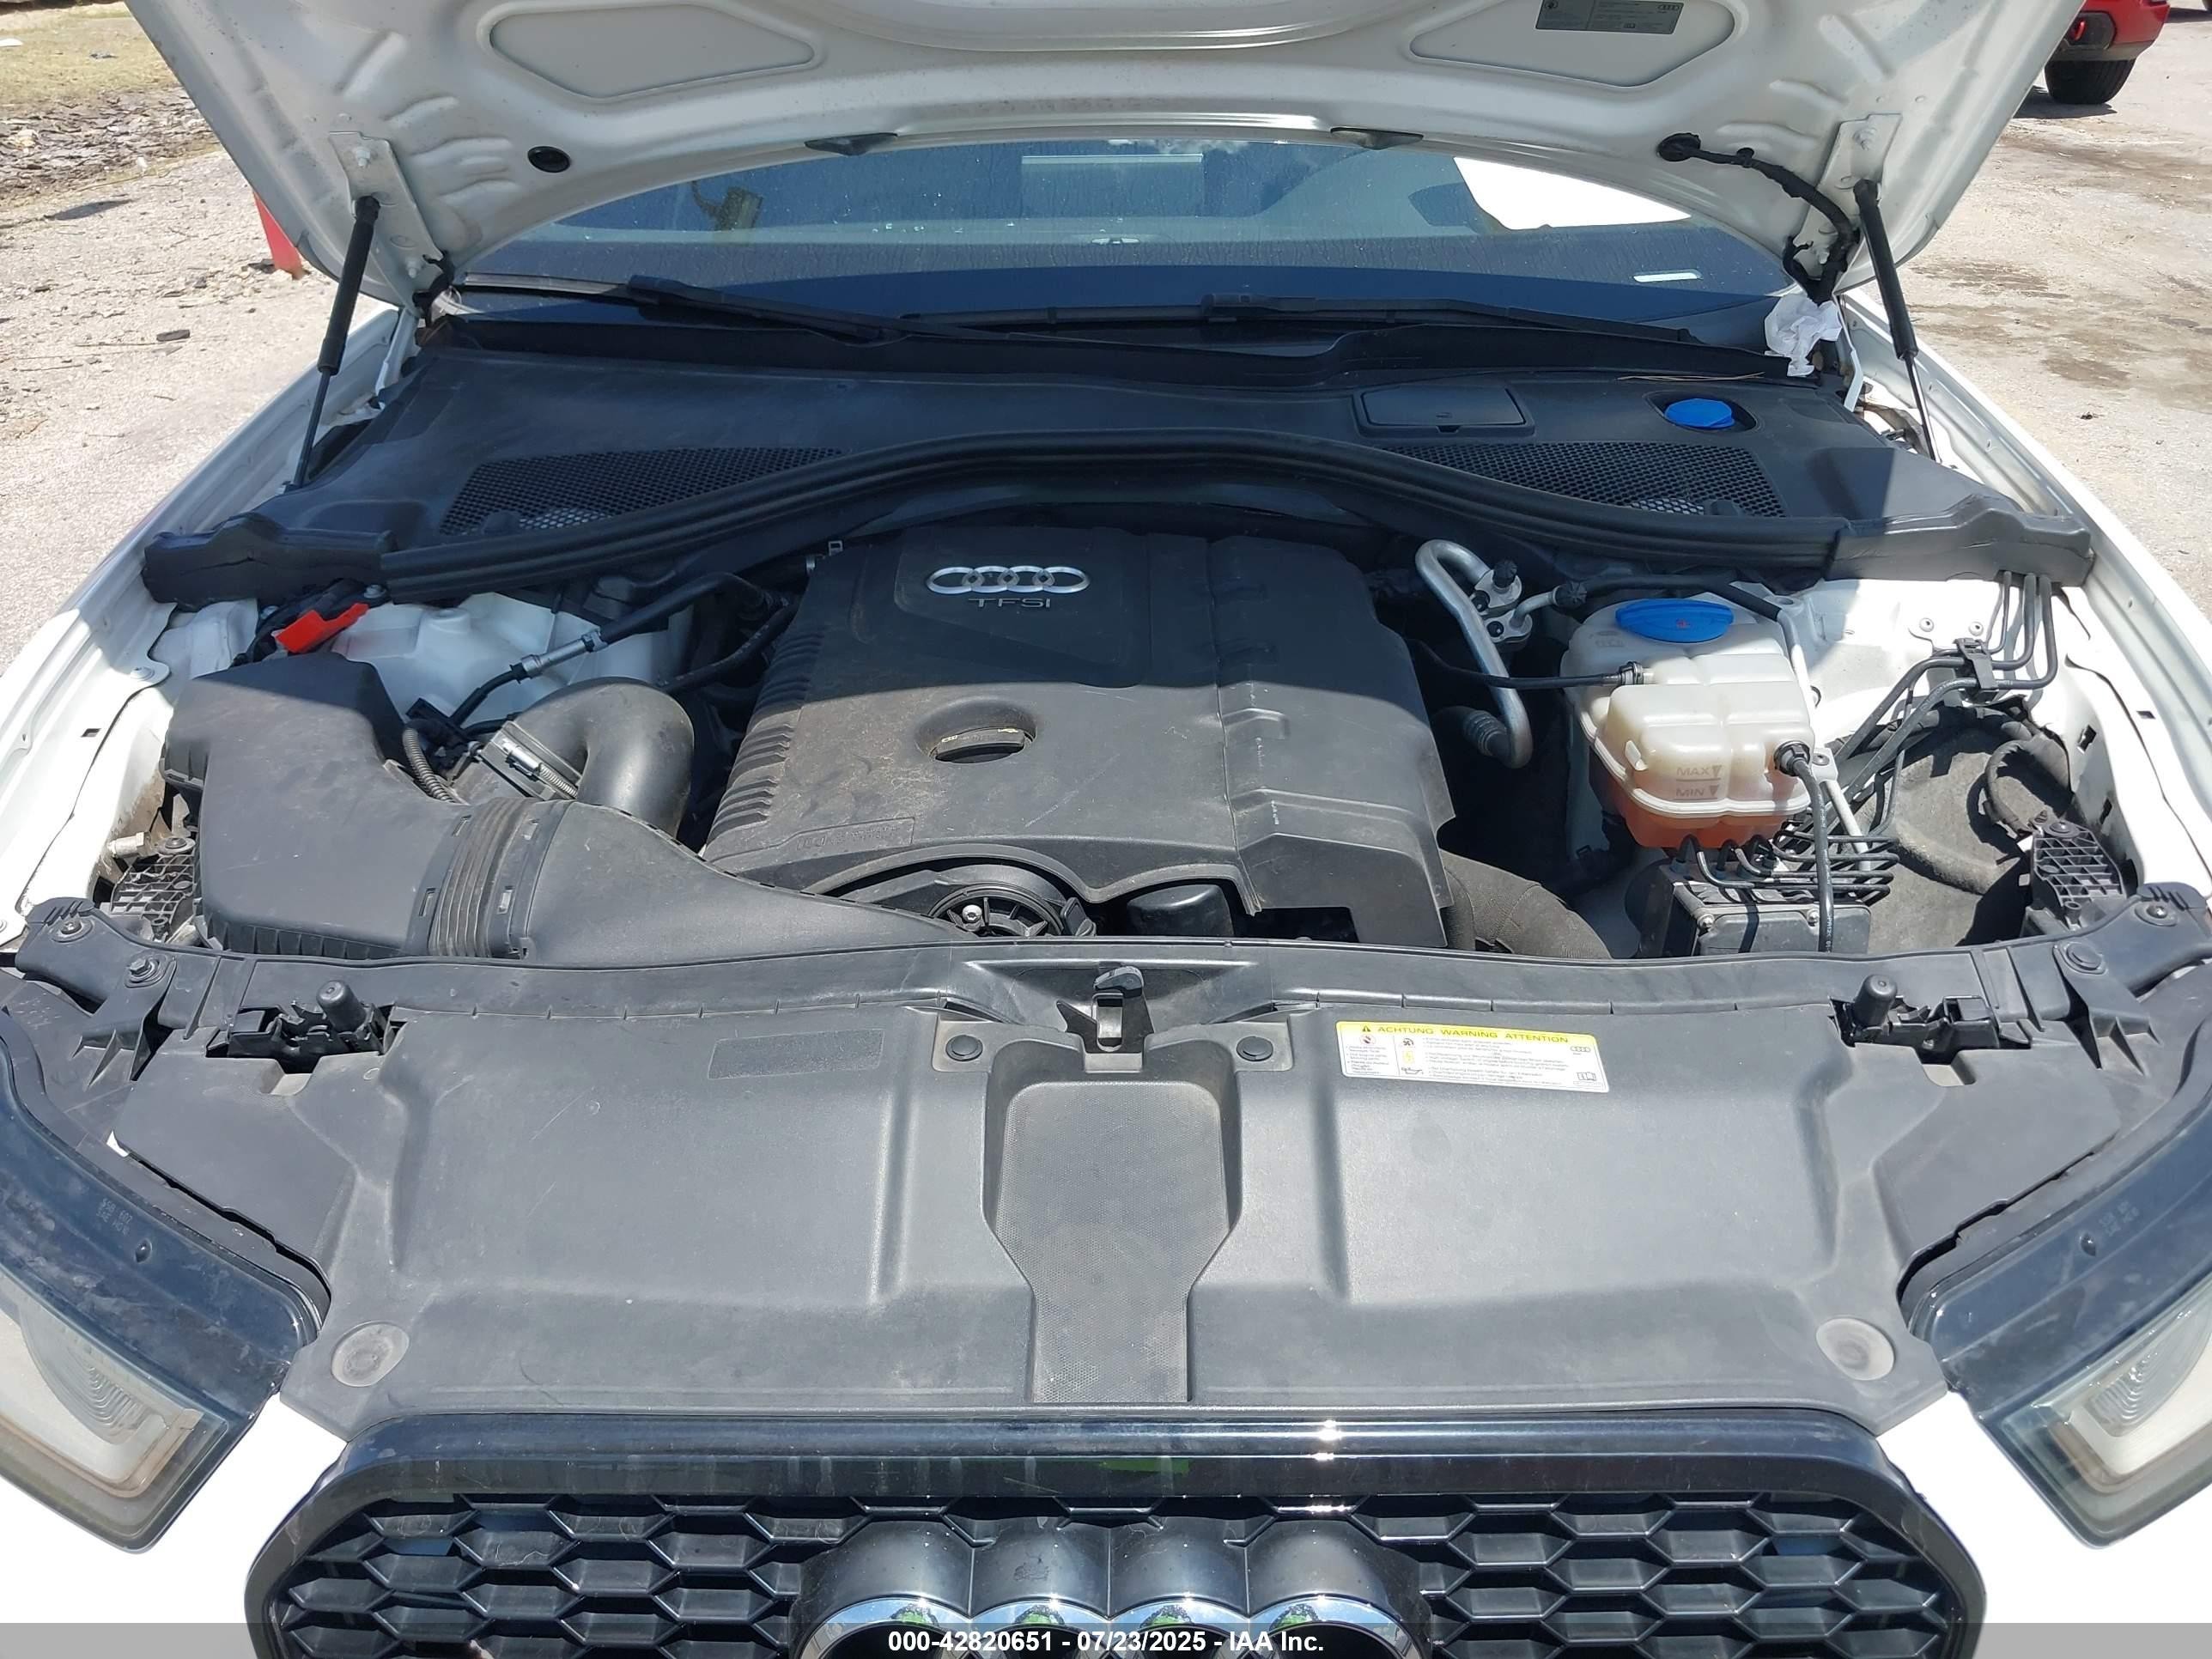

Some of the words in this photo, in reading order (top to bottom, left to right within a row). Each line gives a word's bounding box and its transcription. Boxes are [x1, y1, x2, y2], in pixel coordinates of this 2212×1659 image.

[969, 598, 1051, 608] TFSI
[1676, 767, 1710, 776] MAX
[1675, 788, 1705, 797] MIN
[1376, 1026, 1434, 1035] ACHTUNG
[1441, 1030, 1498, 1038] WARNING
[1504, 1033, 1568, 1042] ATTENTION
